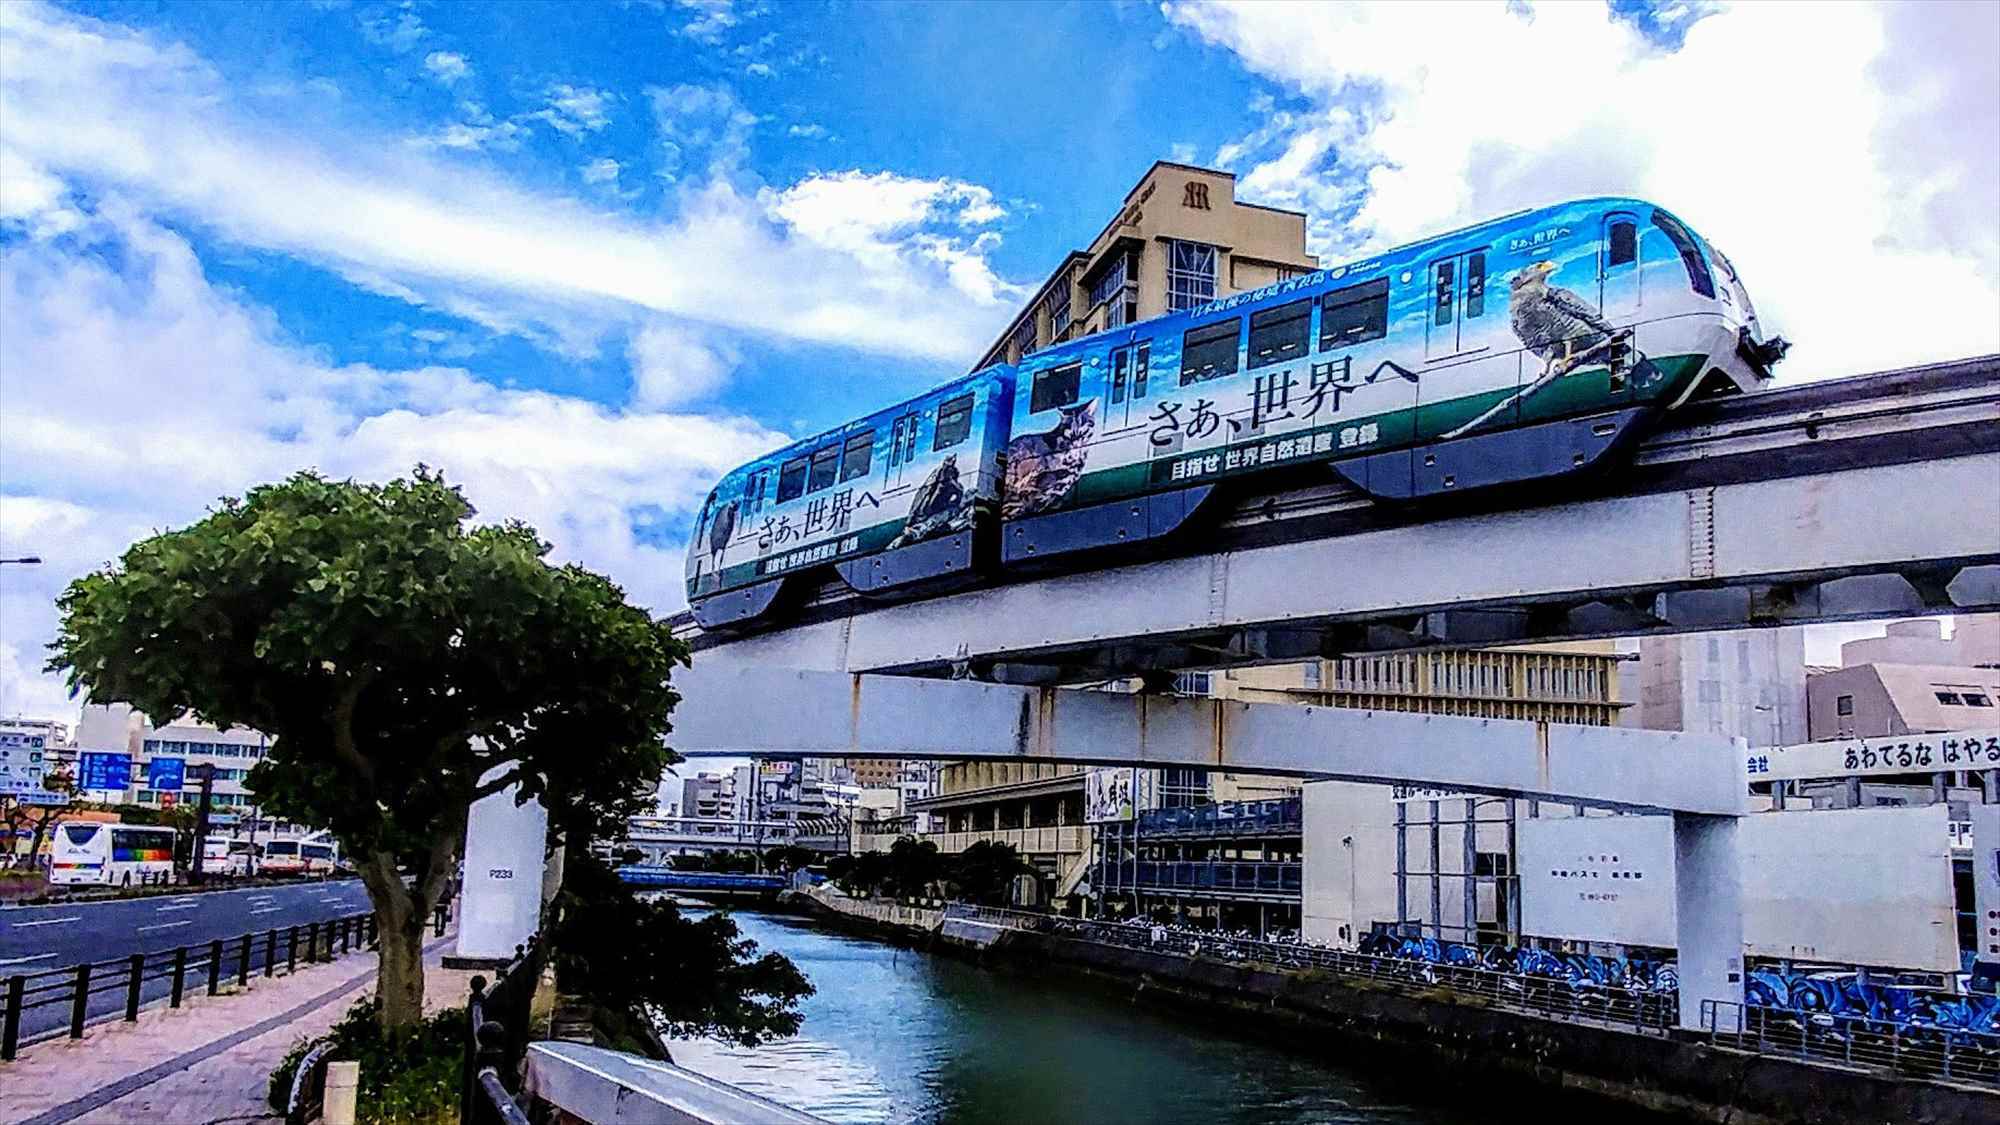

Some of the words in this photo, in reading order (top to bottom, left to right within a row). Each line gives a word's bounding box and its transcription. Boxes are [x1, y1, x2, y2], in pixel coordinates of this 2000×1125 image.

[1149, 355, 1419, 447] さあ、世界へ
[1171, 453, 1219, 481] 目指せ
[759, 487, 879, 550] さあ、世界へ
[1747, 755, 1769, 774] 会社
[1844, 742, 1932, 770] あわてるな
[1943, 736, 2000, 763] はやる
[489, 869, 513, 879] P233
